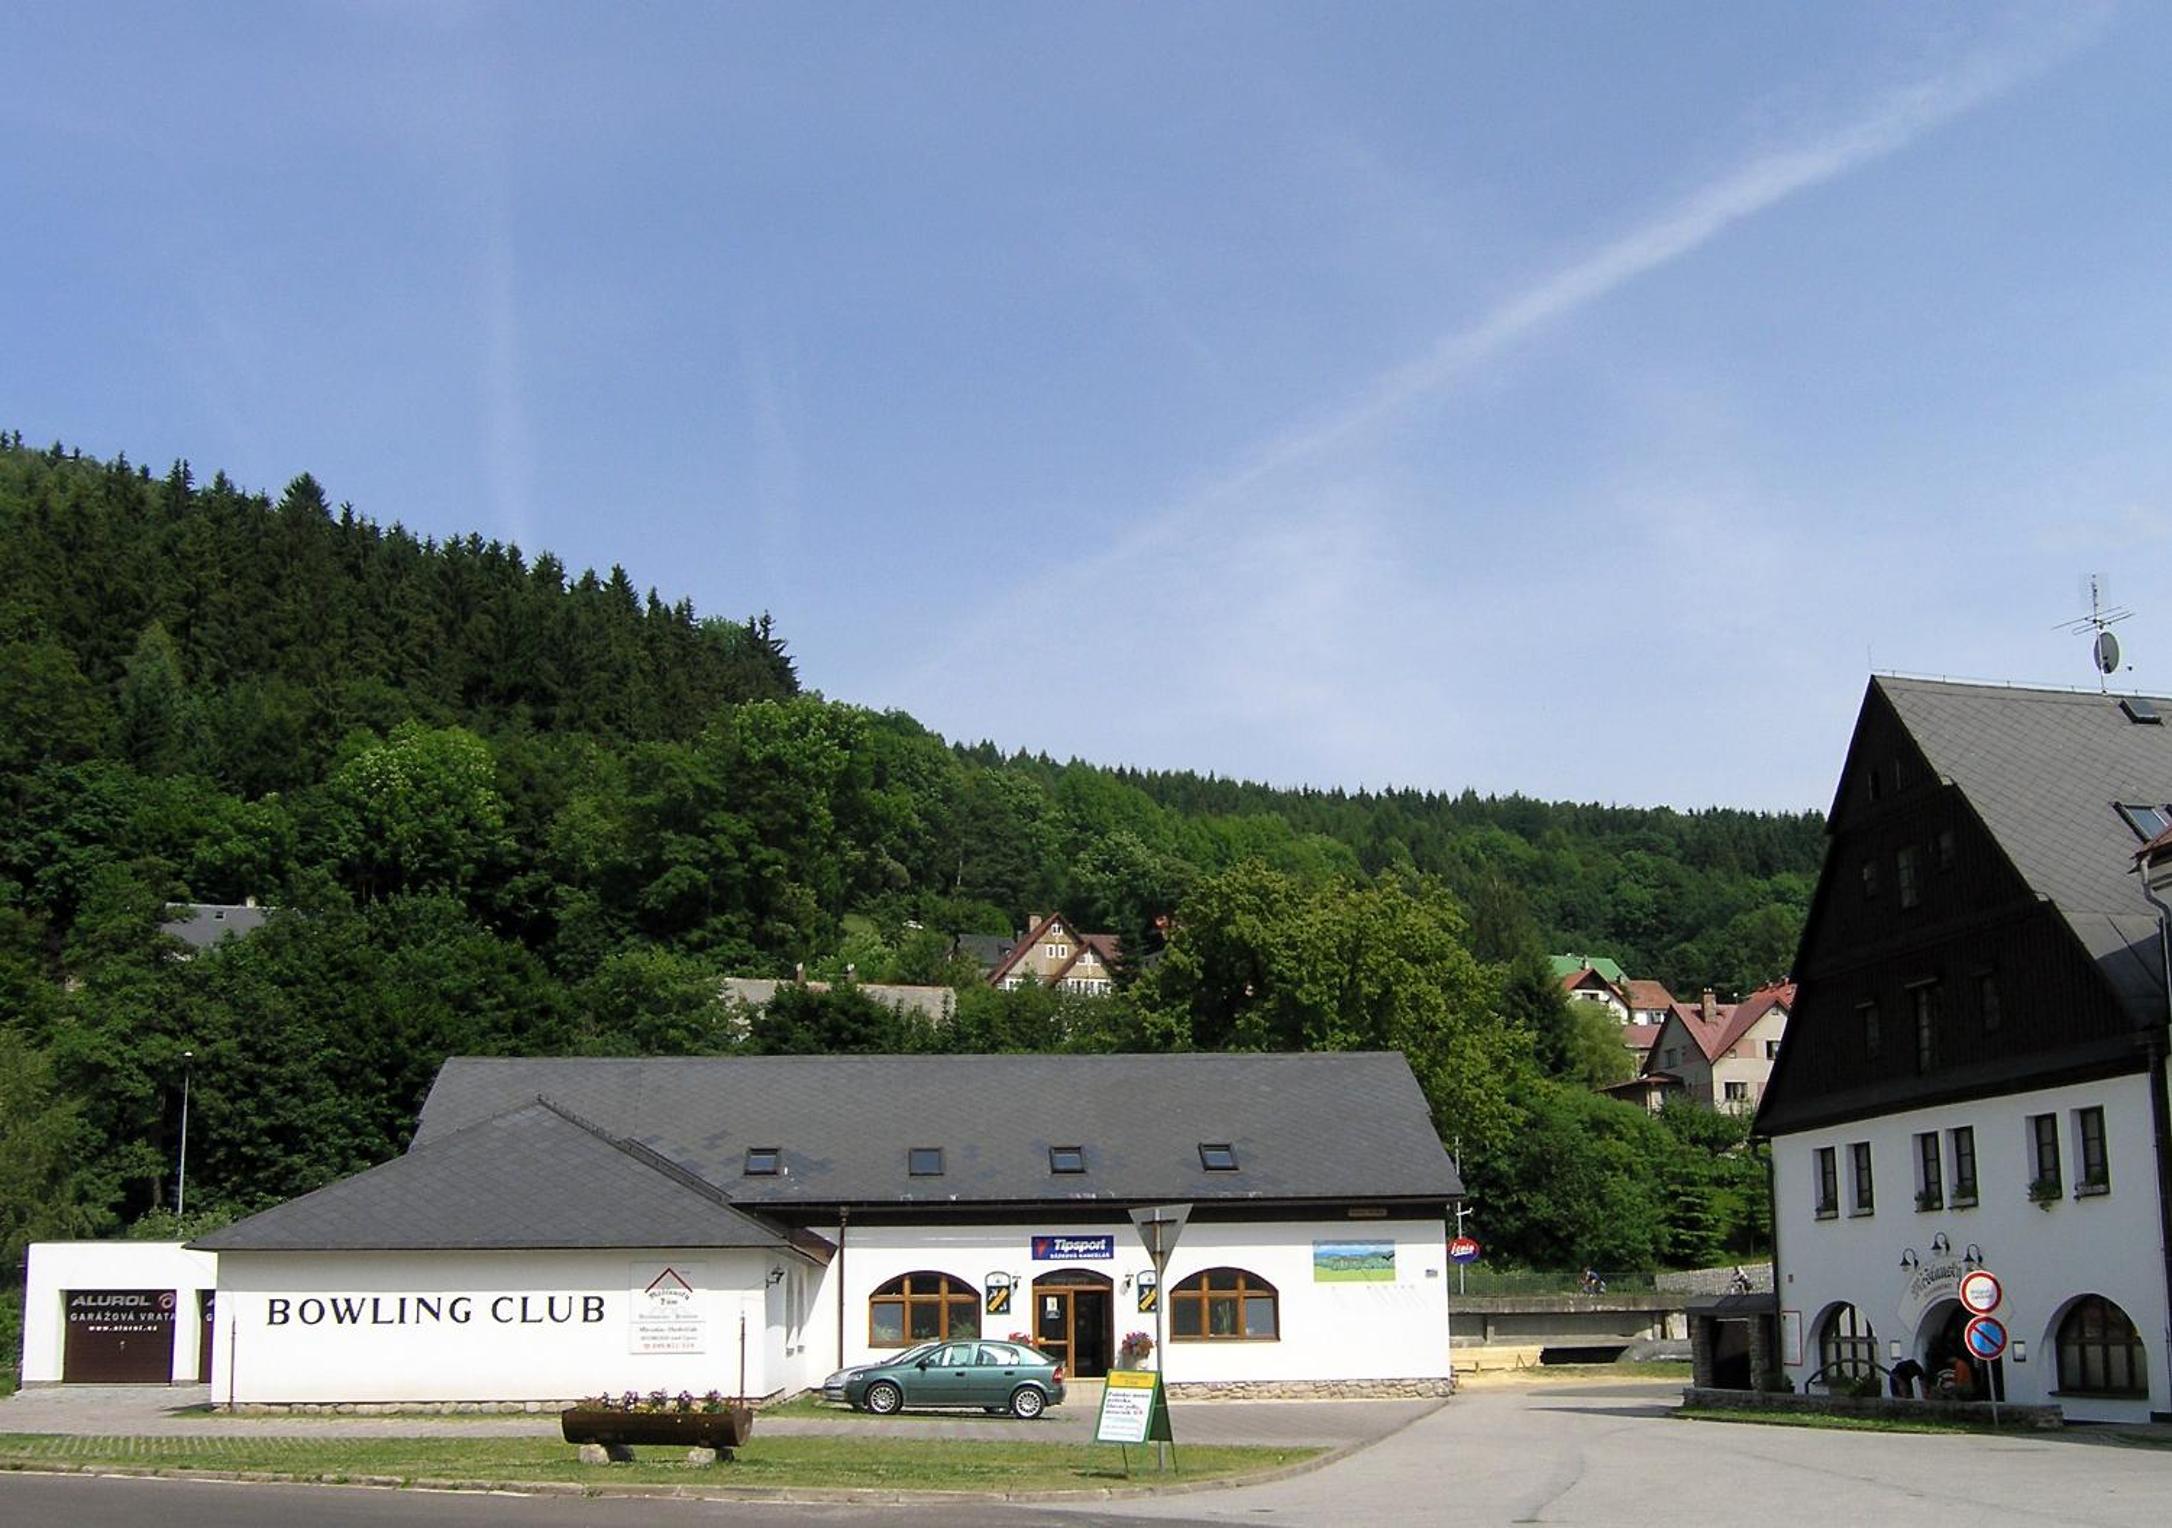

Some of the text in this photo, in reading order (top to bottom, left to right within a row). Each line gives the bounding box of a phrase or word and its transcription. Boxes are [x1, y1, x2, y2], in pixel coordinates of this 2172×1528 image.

[1054, 1239, 1106, 1252] Tipsport
[71, 1295, 151, 1306] ALUROL
[70, 1309, 135, 1322] GARÁŽOVÁ
[267, 1295, 606, 1326] BOWLING CLUB
